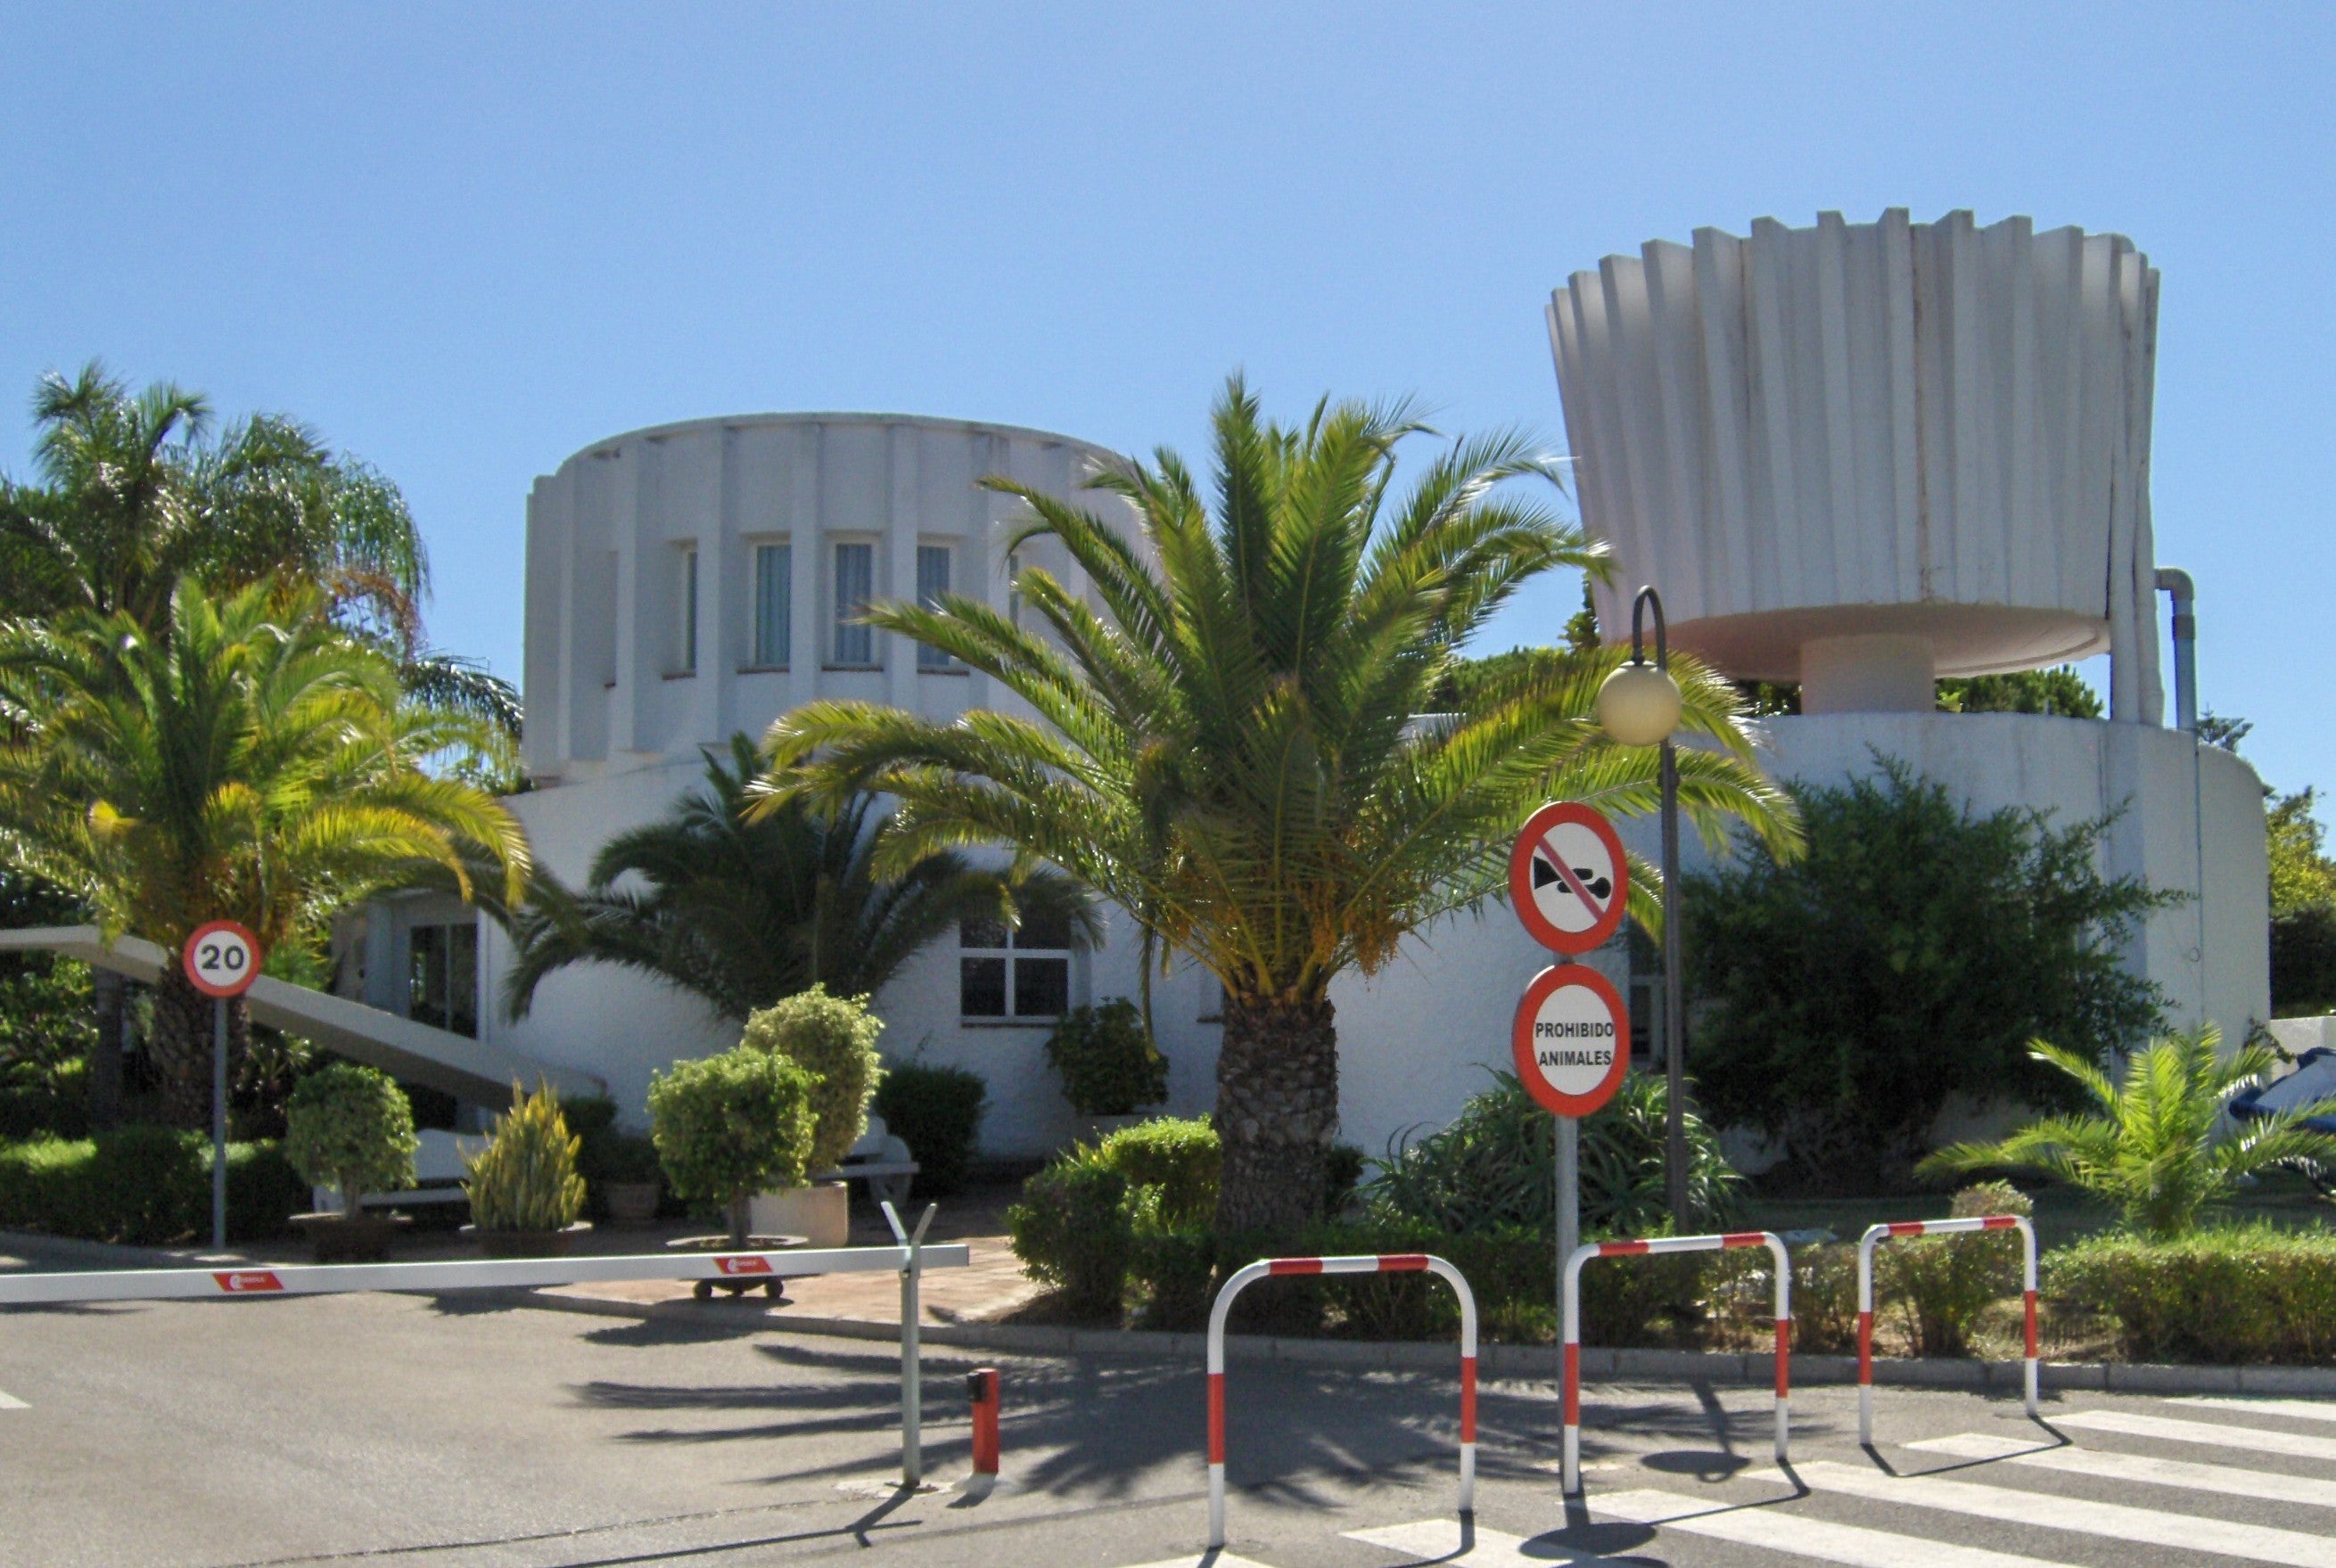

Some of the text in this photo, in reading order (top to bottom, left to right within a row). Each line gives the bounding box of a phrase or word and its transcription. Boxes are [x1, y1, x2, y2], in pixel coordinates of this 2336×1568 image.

[202, 944, 244, 970] 20
[1535, 1022, 1614, 1038] PROHIBIDO
[1539, 1050, 1612, 1066] ANIMALES
